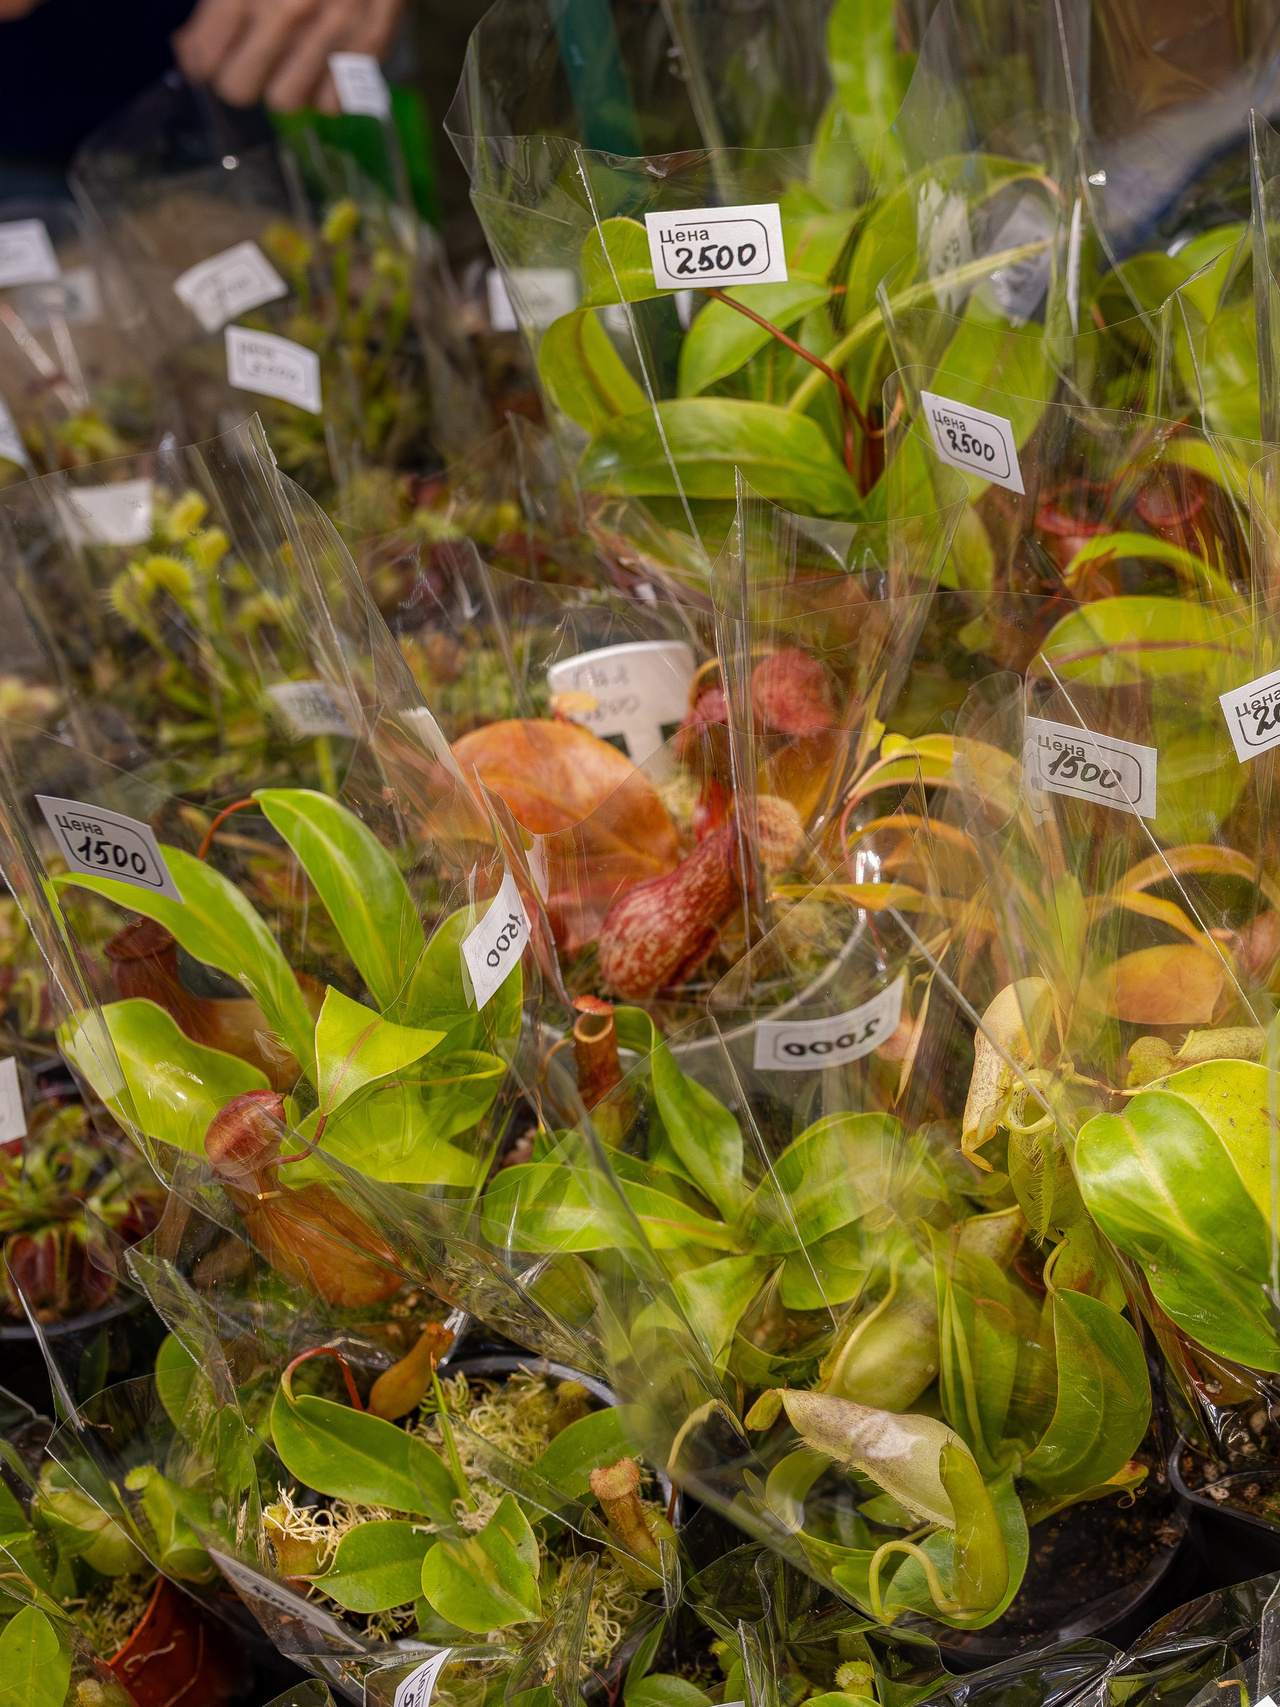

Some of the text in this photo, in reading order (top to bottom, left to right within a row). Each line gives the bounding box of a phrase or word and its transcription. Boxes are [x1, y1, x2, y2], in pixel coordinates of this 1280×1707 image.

[660, 229, 710, 244] Цена
[675, 243, 757, 274] 2500
[933, 409, 966, 432] Цена
[946, 429, 995, 462] 2500
[1038, 734, 1086, 758] Цена
[1048, 750, 1122, 788] 1500
[54, 814, 105, 836] Цена
[77, 836, 146, 875] 1500
